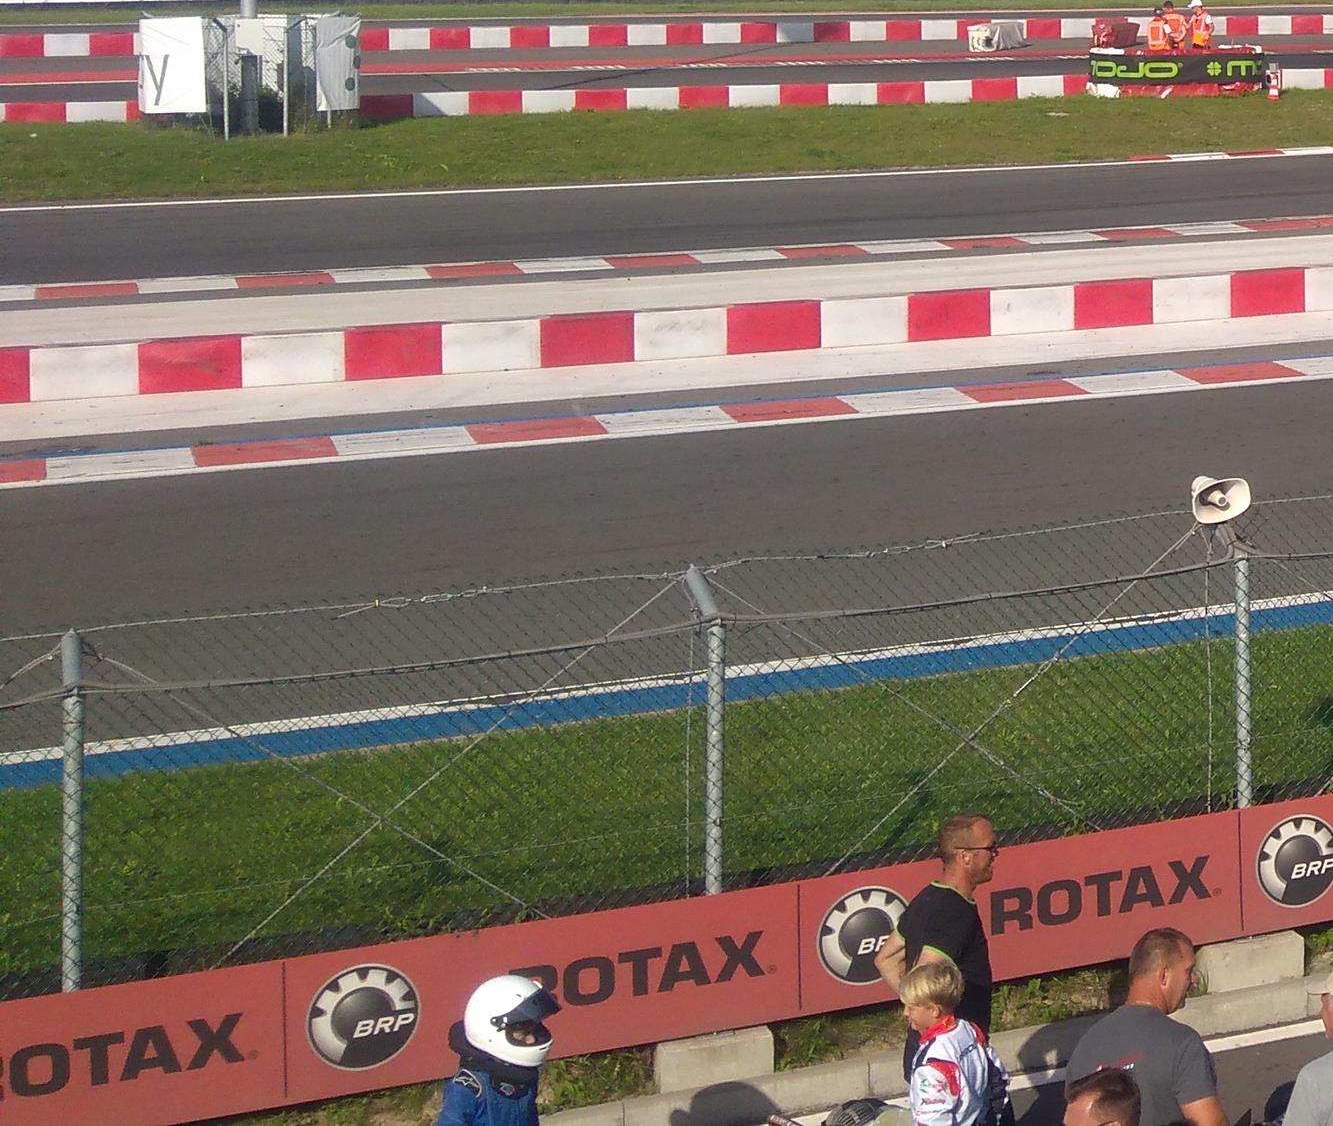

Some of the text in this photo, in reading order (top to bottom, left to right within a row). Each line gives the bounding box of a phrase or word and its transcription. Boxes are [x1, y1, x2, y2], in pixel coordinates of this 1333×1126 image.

[990, 855, 1211, 936] ROTAX
[0, 1013, 243, 1098] OTAX
[353, 1012, 415, 1039] BRP
